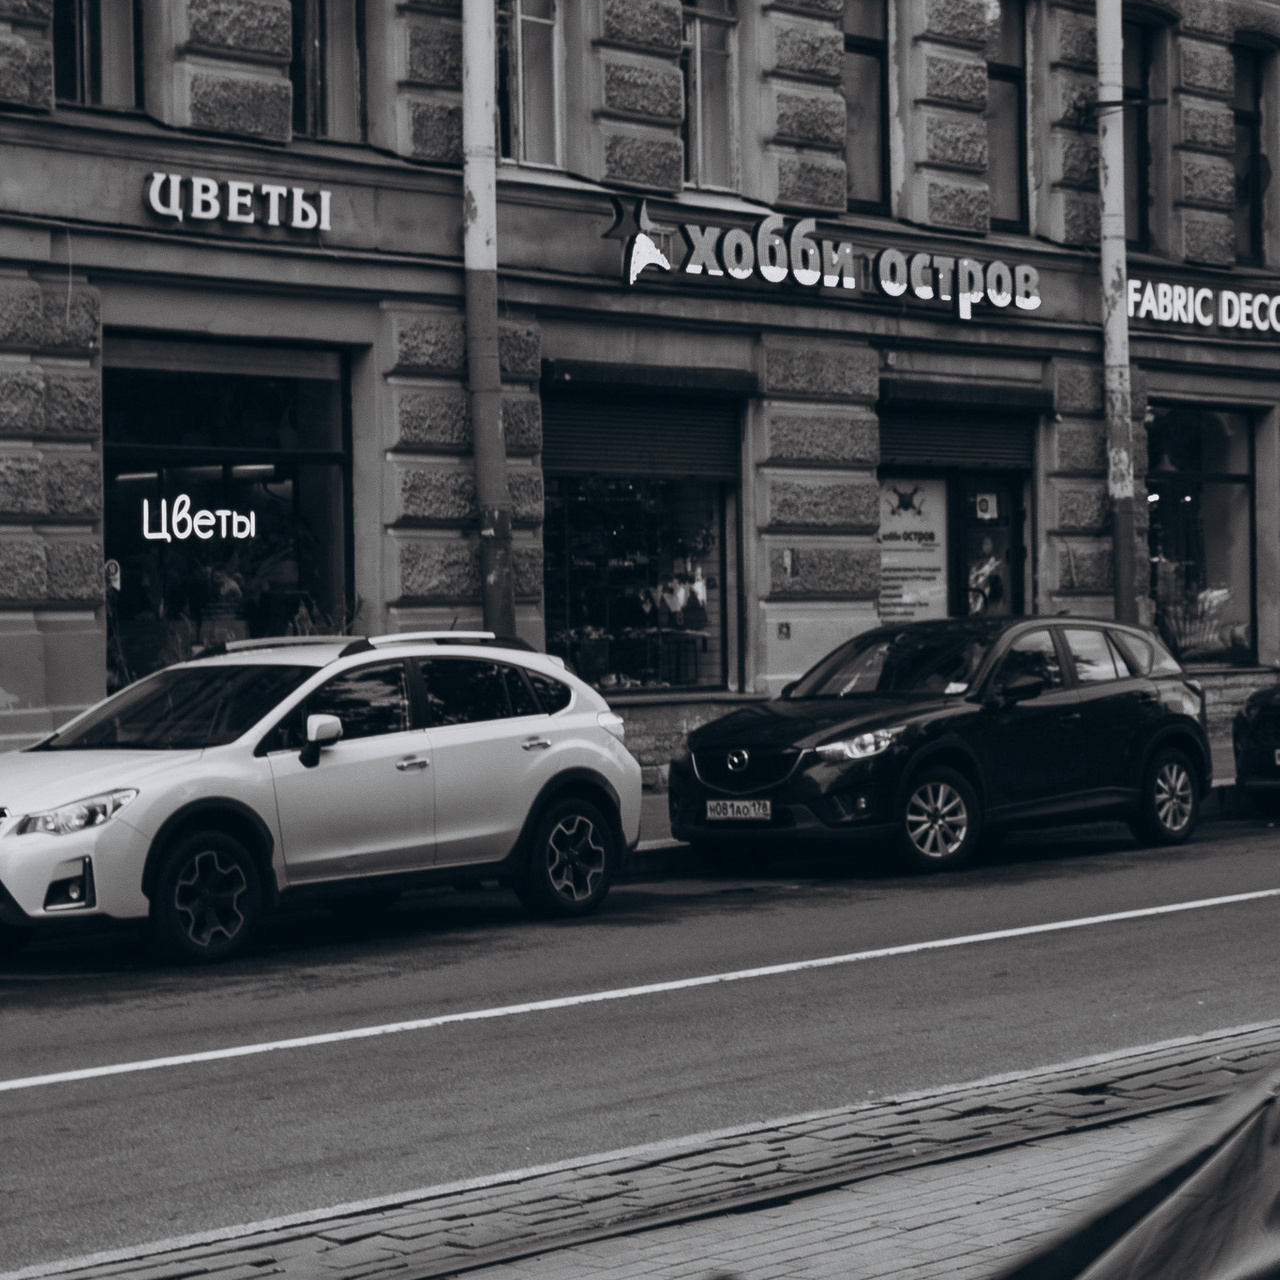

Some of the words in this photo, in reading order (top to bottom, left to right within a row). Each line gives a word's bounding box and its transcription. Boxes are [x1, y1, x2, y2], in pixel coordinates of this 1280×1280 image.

[149, 172, 331, 231] ЦВЕТЫ
[684, 213, 856, 289] хобби
[879, 248, 1042, 320] остров
[1127, 279, 1213, 326] FABRIC
[143, 493, 256, 543] Цветы
